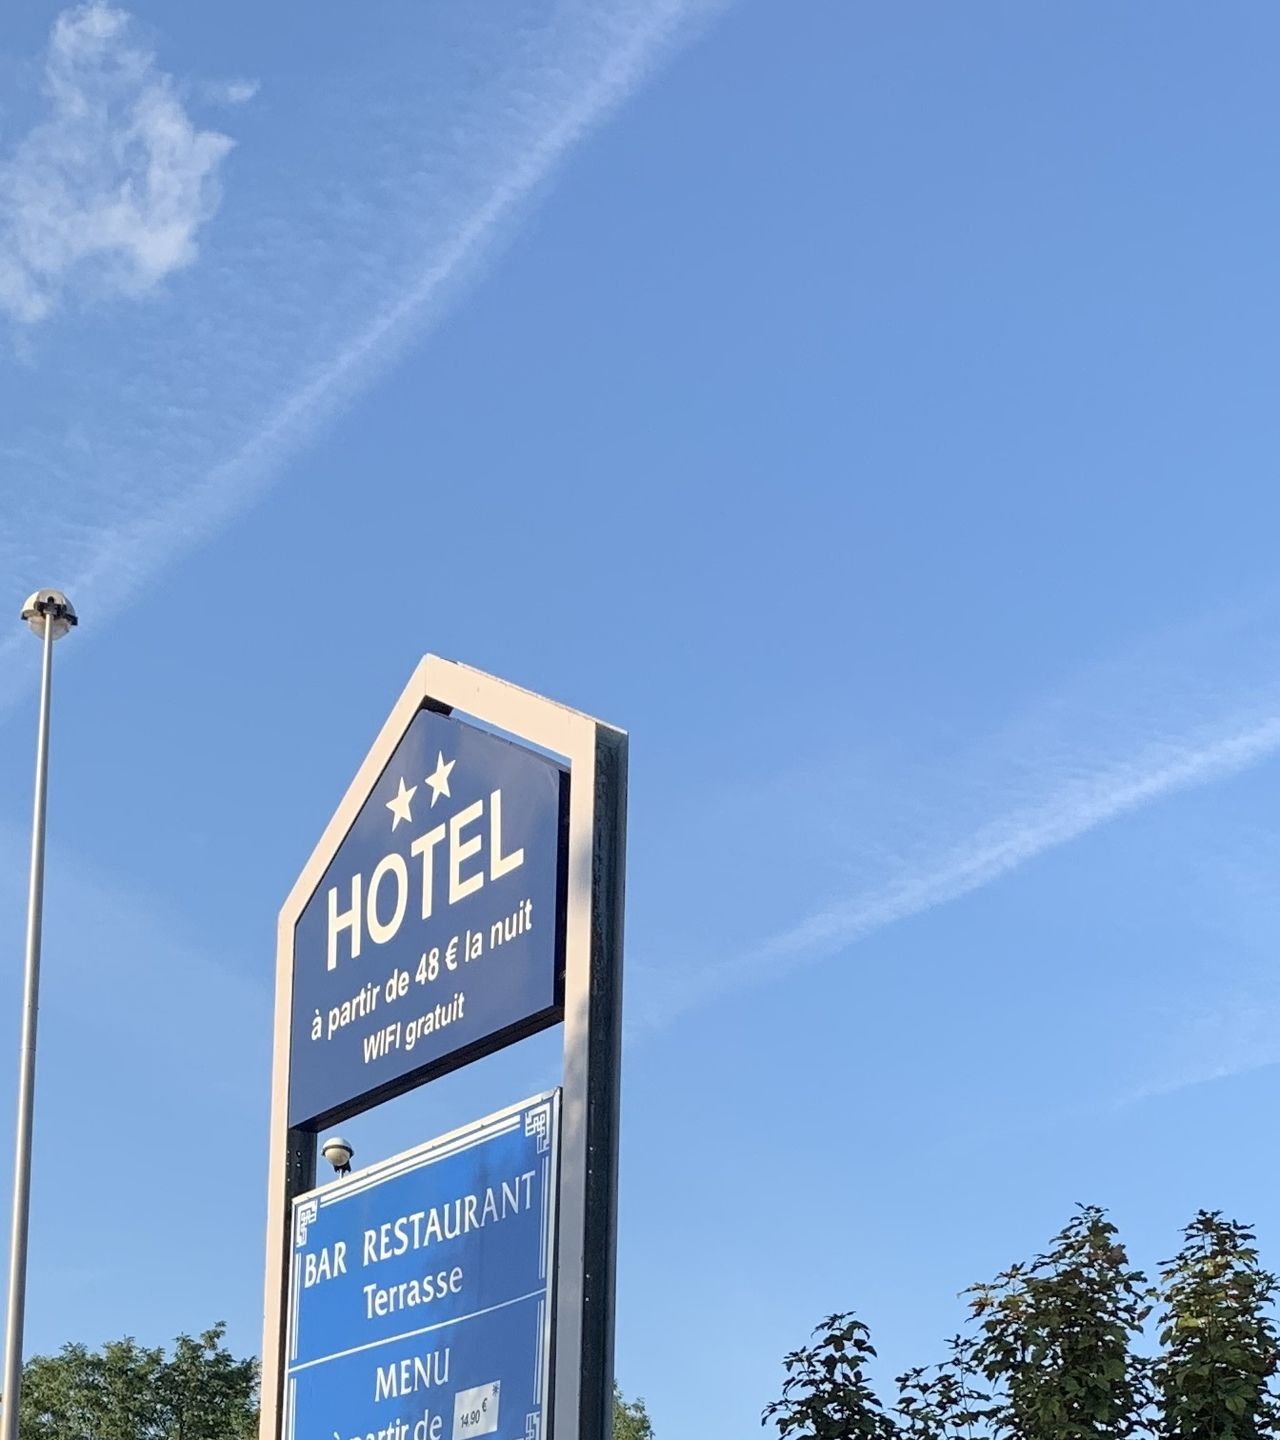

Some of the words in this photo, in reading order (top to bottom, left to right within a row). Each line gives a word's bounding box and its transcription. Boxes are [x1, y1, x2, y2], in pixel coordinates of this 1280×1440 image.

[327, 788, 524, 972] HOTEL
[311, 1009, 322, 1041] à
[327, 982, 381, 1041] partir
[386, 968, 410, 1003] de
[415, 947, 440, 985] 48
[445, 935, 459, 971] €
[465, 929, 483, 963] la
[490, 898, 533, 950] nuit
[362, 1021, 401, 1065] WIFI
[405, 991, 465, 1051] gratuit
[304, 1240, 347, 1289] BAR
[362, 1169, 536, 1268] RESTAURANT
[363, 1265, 463, 1320] Terrasse
[374, 1347, 450, 1403] MENU
